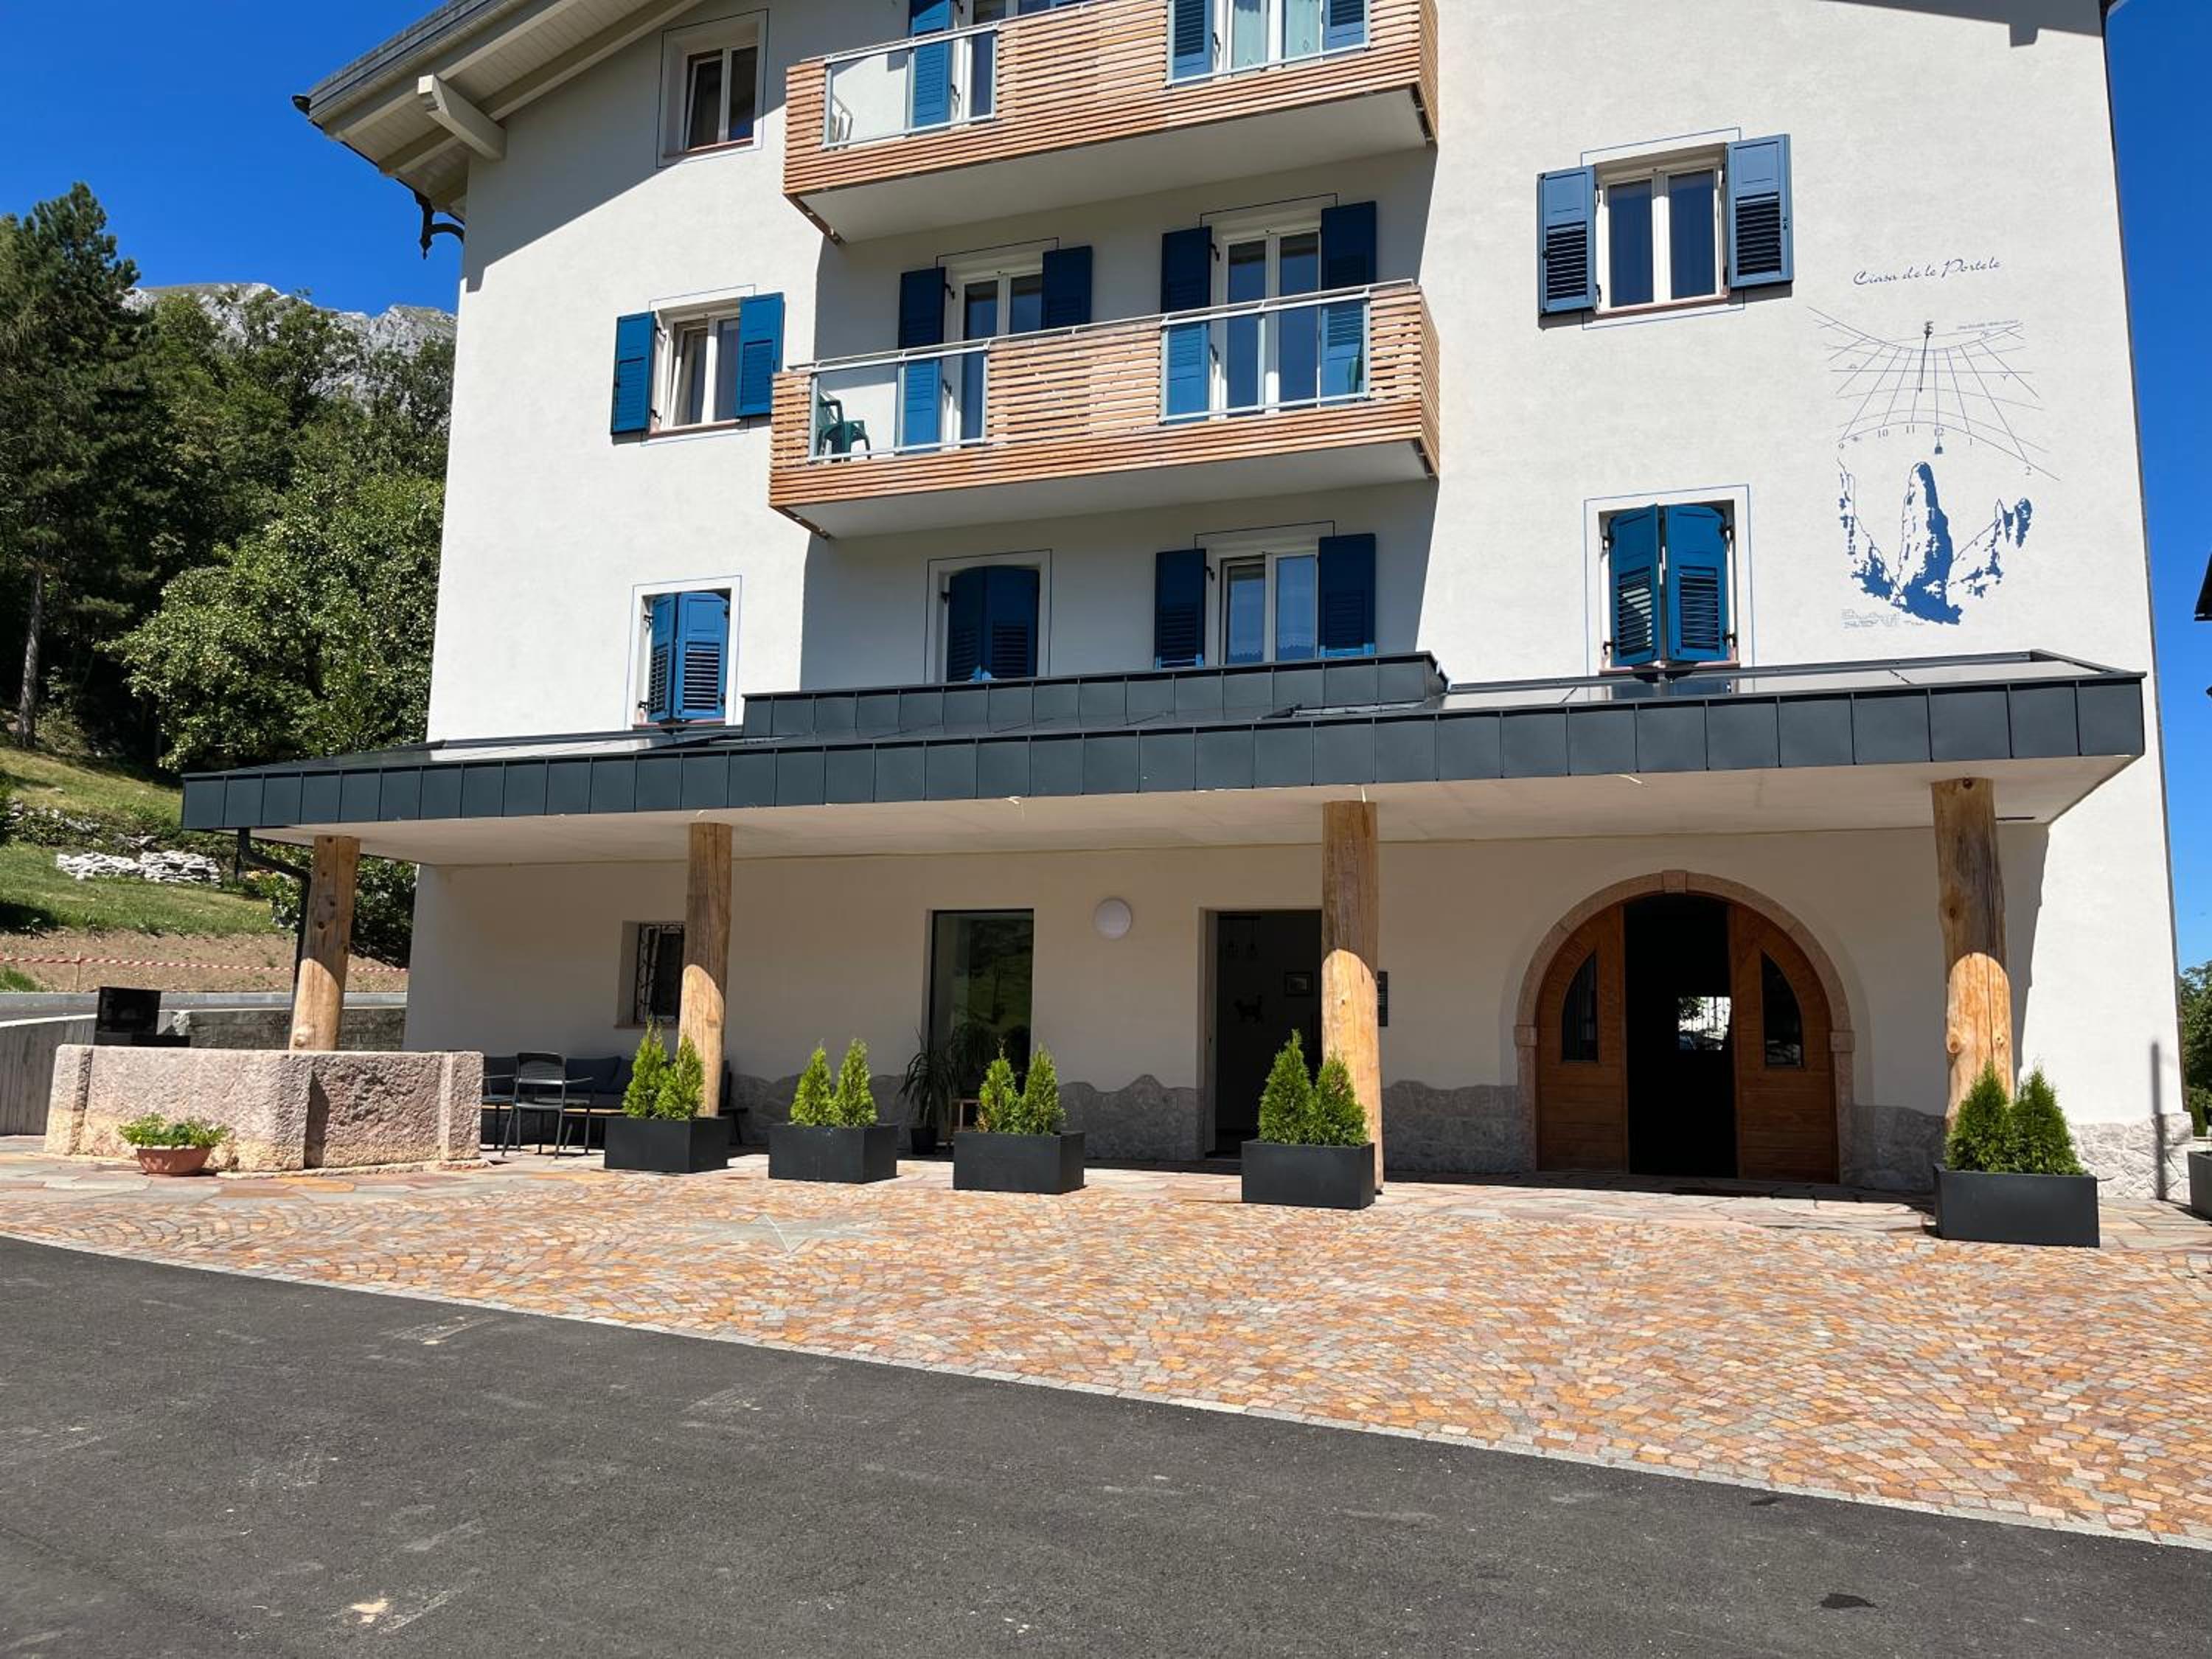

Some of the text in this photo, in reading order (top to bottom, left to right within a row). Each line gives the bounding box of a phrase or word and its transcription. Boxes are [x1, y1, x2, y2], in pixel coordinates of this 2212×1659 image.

[1877, 428, 1888, 438] 10
[1906, 424, 1915, 434] 11
[1934, 428, 1944, 437] 12
